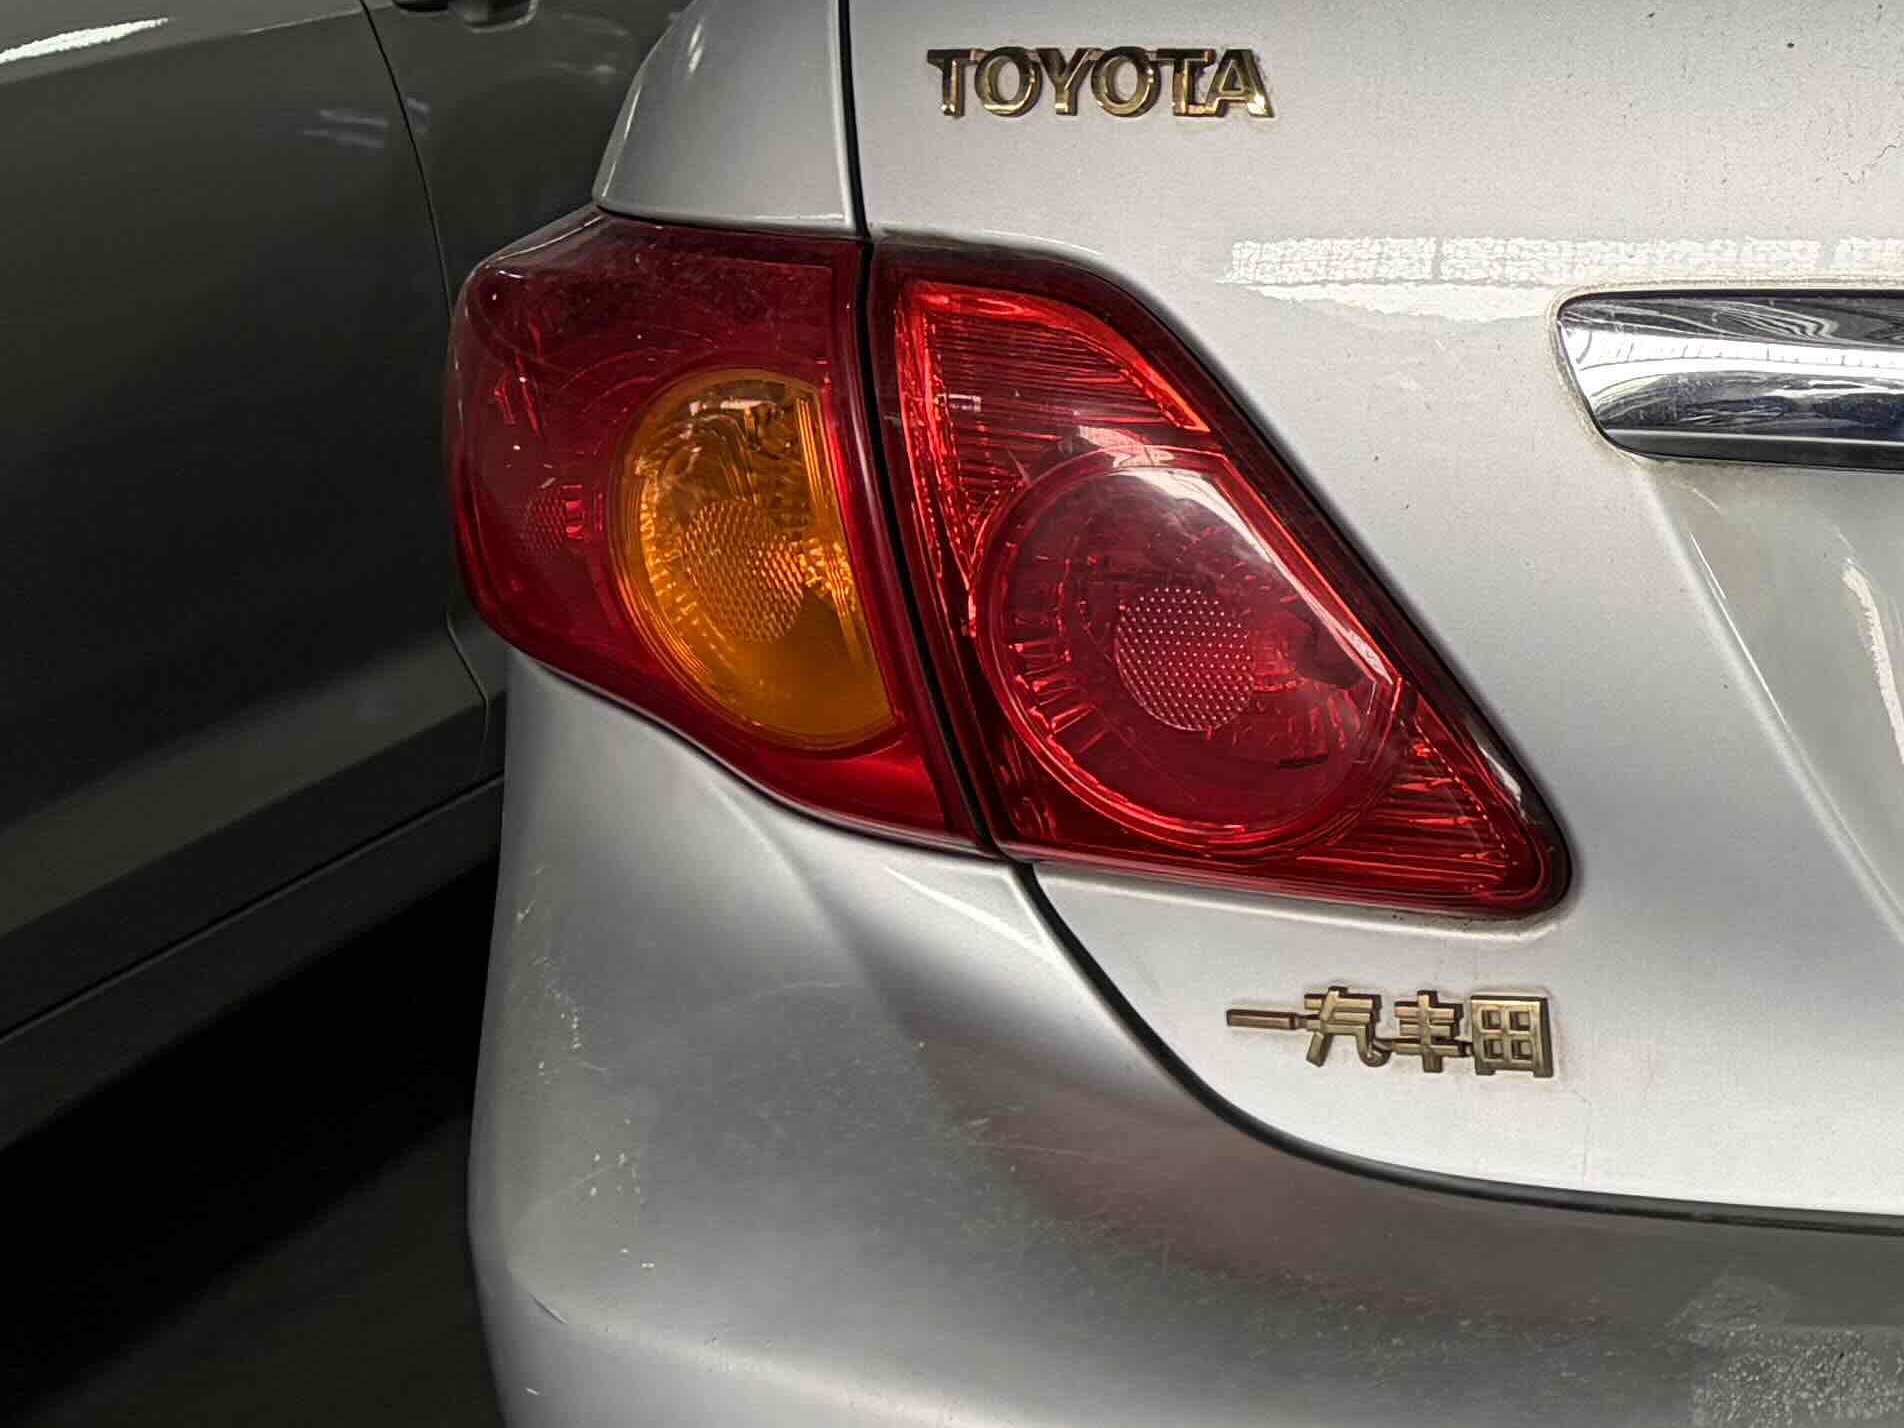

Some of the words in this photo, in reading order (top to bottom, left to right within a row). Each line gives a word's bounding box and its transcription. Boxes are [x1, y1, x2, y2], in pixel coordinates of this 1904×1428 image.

[926, 45, 1276, 119] TOYOTA
[1225, 984, 1556, 1079] 一汽丰田
